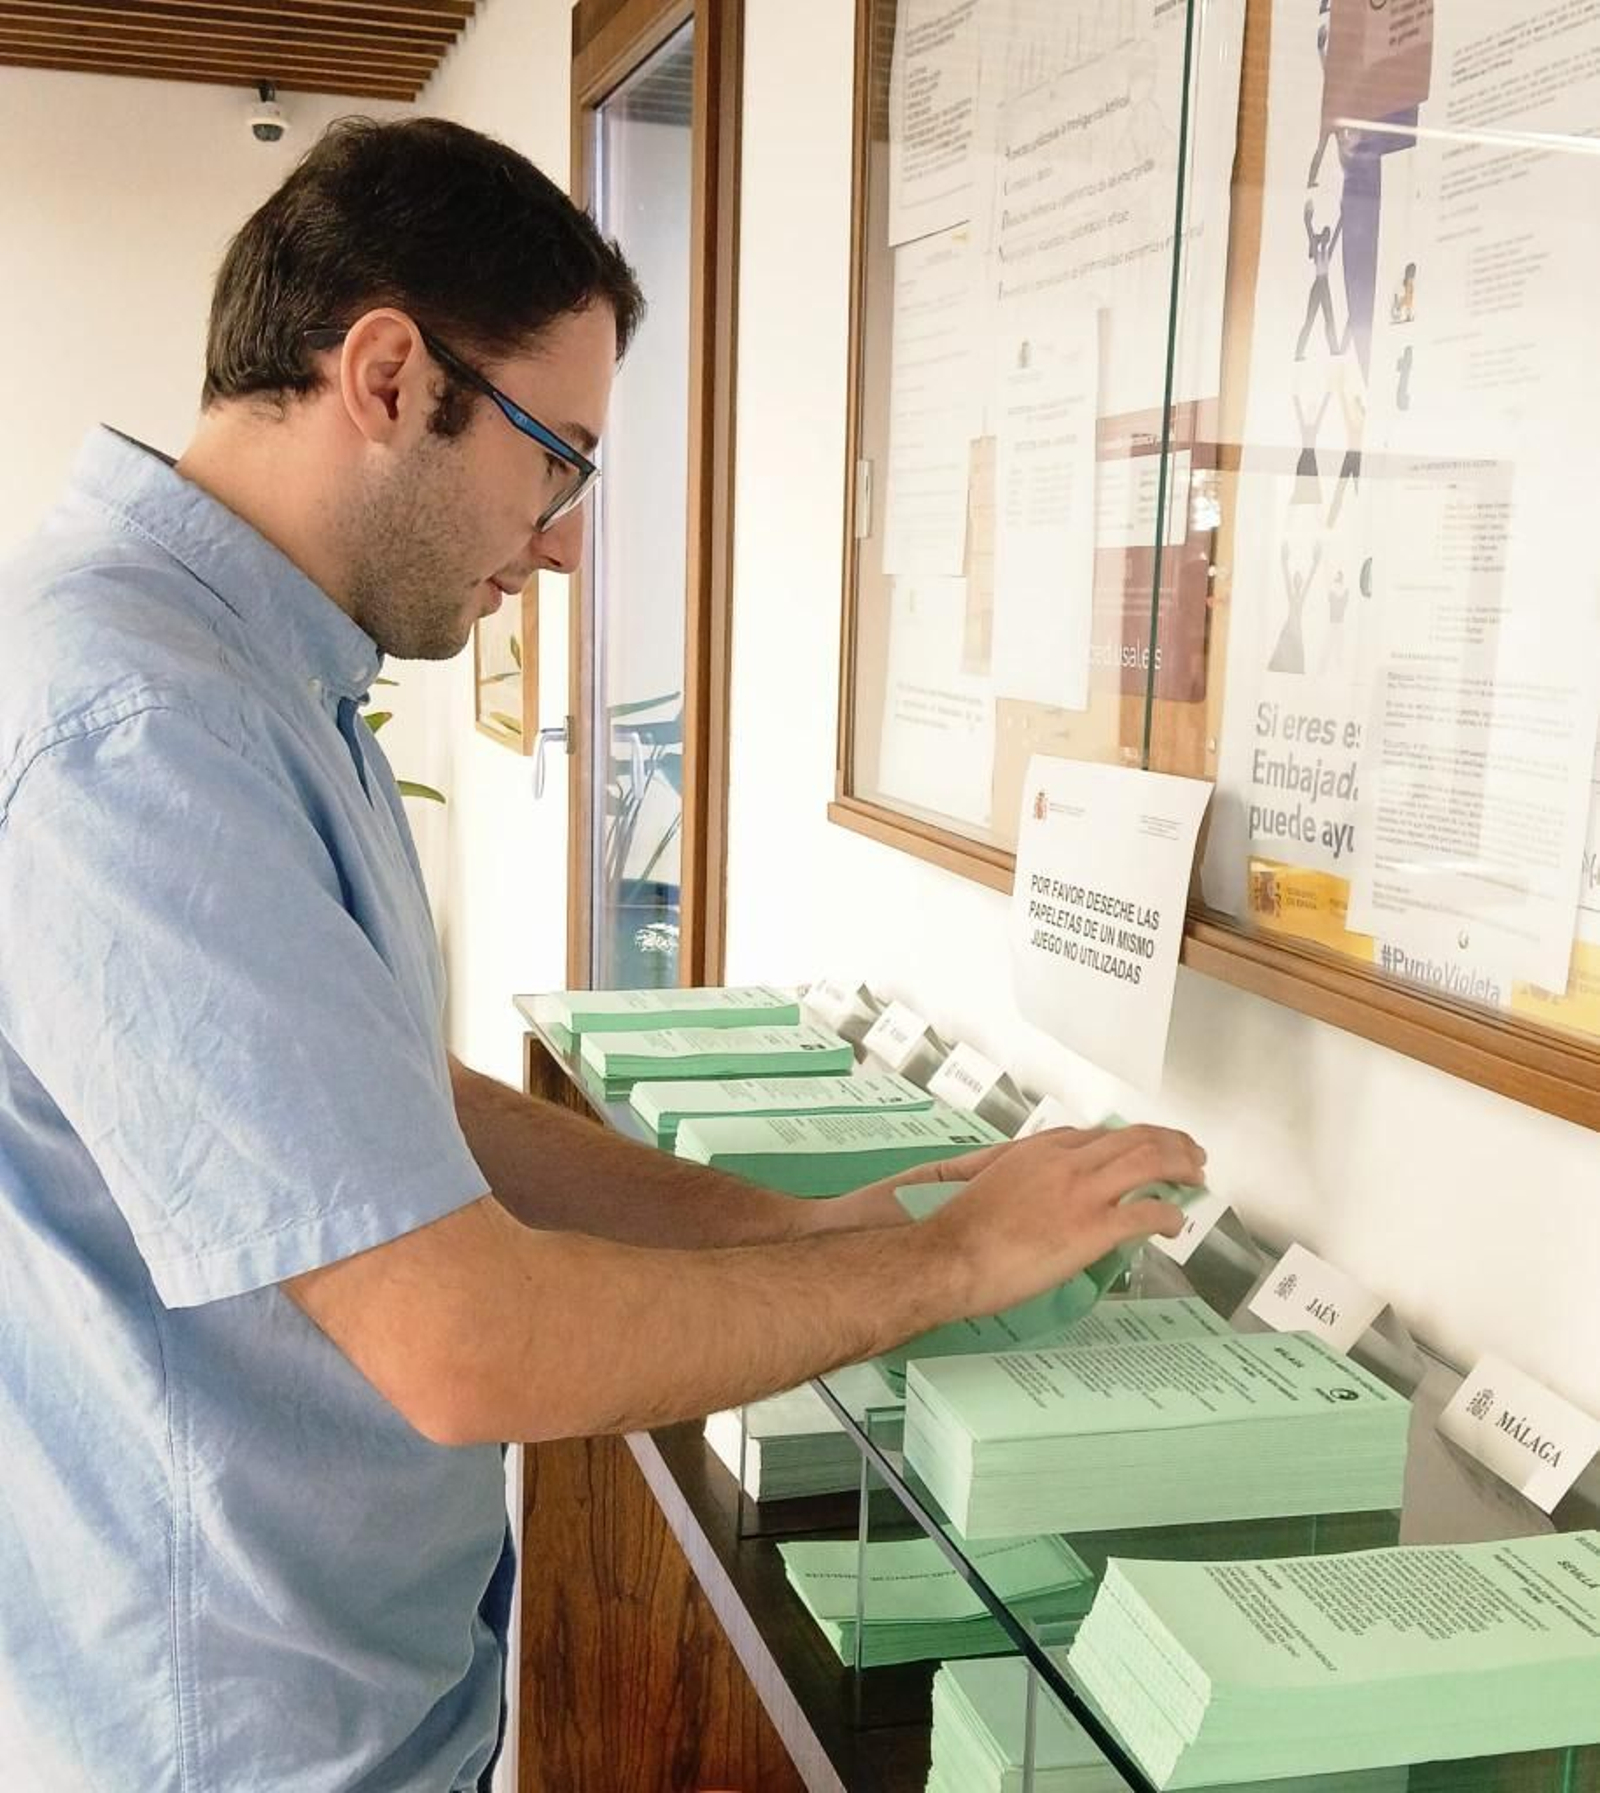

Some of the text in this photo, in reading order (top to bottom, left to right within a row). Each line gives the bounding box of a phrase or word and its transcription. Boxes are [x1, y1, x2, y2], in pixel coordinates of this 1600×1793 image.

[1256, 702, 1278, 737] Si
[1283, 713, 1337, 745] eres
[1249, 802, 1317, 843] puede
[1029, 900, 1154, 959] PAPELETAS DE UN MISMO
[1031, 874, 1160, 930] POR FAVOR DESECHE LAS
[1031, 929, 1142, 984] JUEGO NO UTILIZADAS
[1380, 943, 1500, 1004] #PuntoVioleta
[1306, 1298, 1340, 1326] JAÉN
[1495, 1410, 1562, 1468] MÁLAGA
